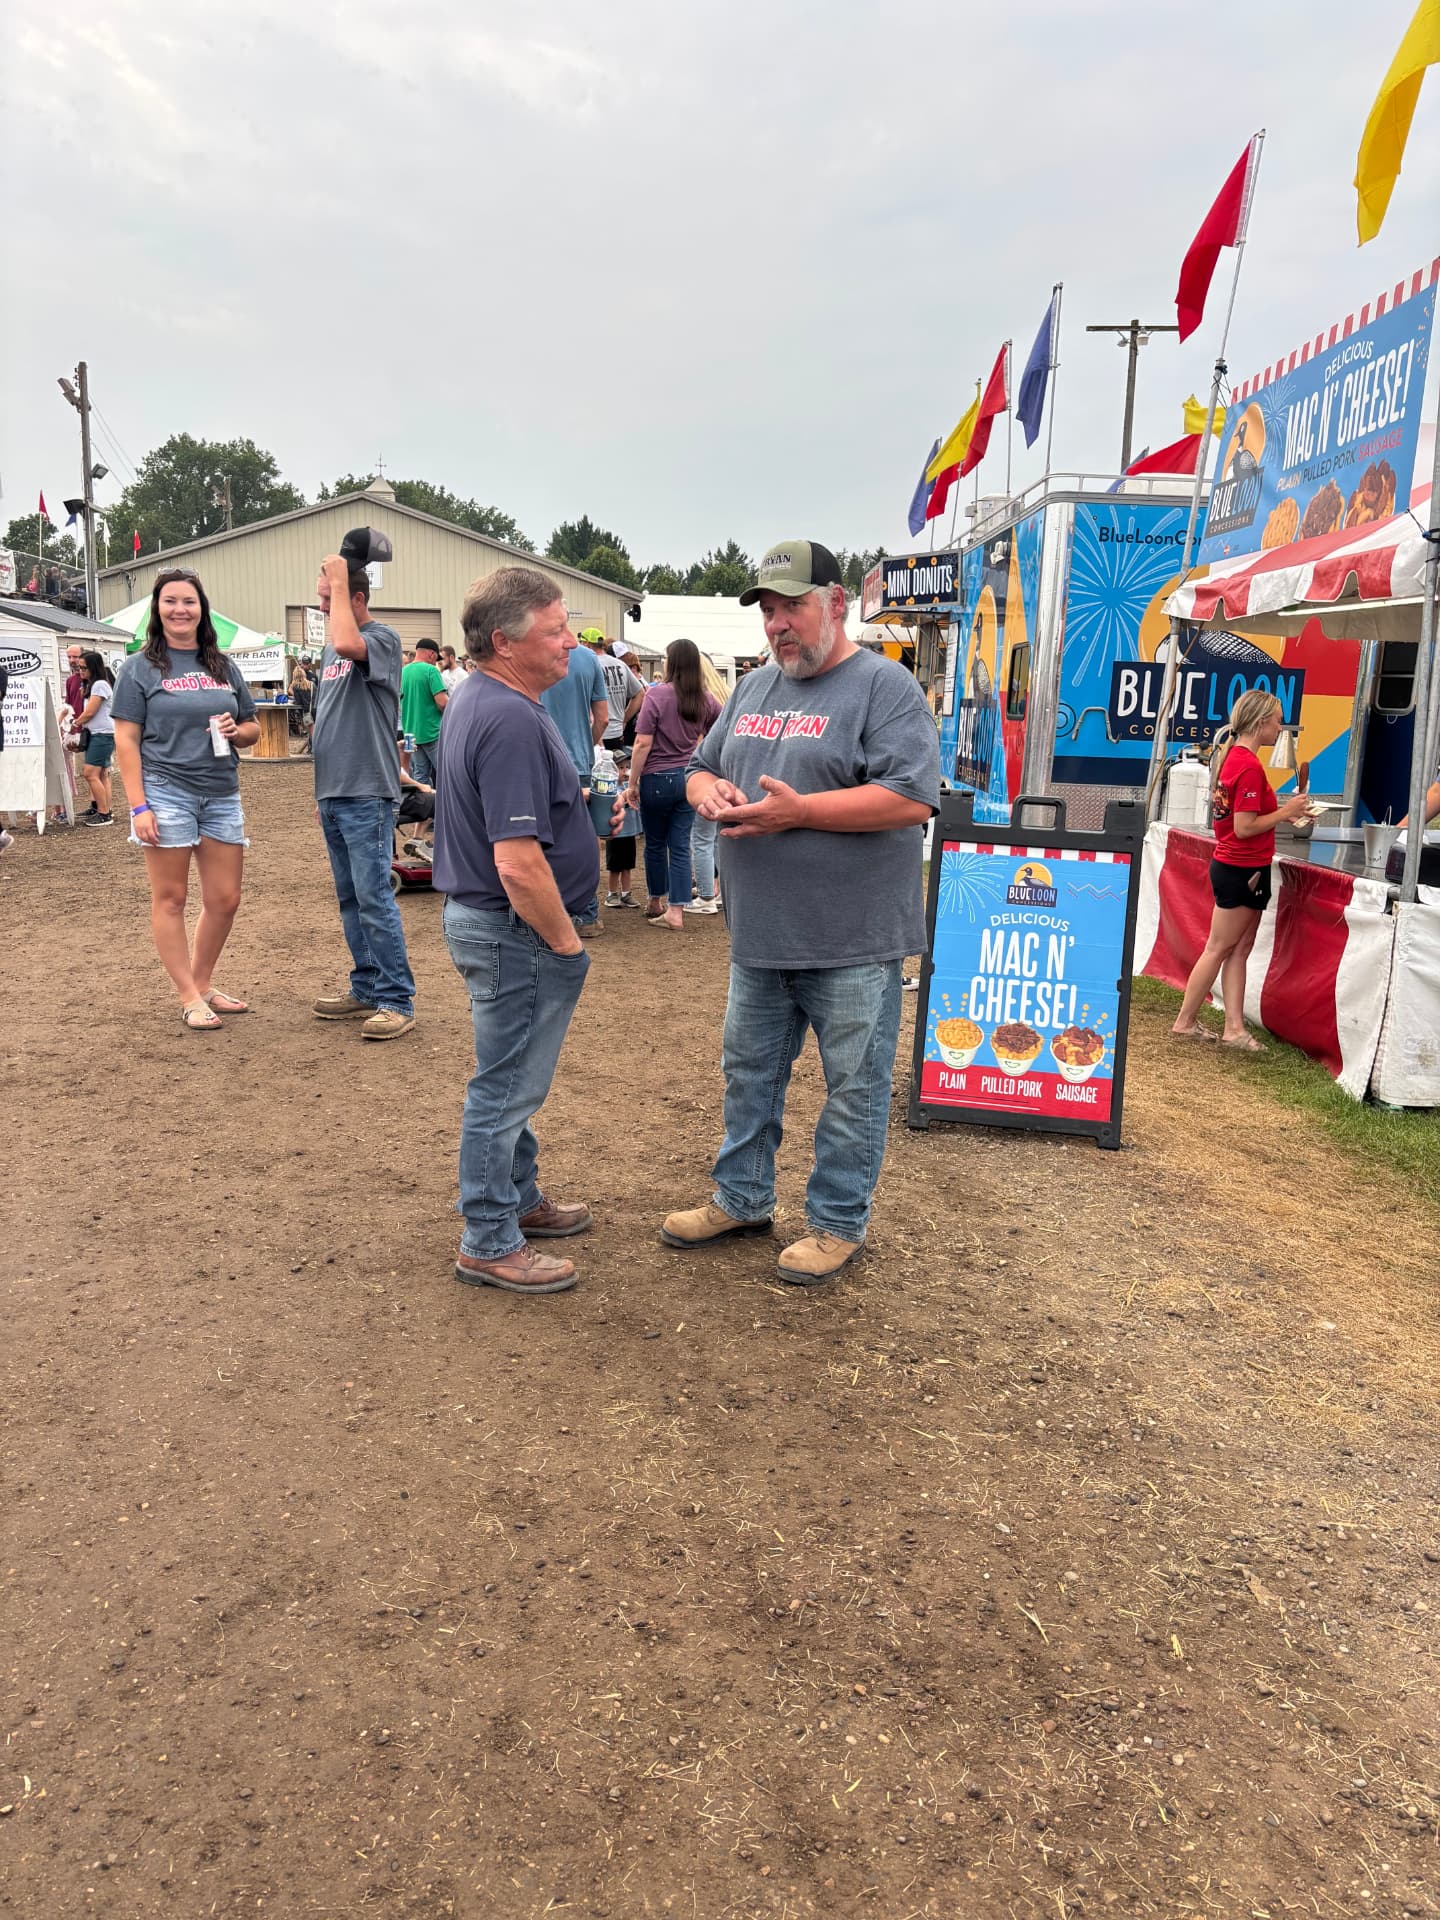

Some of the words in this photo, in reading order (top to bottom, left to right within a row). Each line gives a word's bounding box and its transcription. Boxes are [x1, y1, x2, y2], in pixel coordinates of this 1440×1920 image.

[1324, 340, 1374, 384] DELICIOUS
[1282, 391, 1319, 472] MAC
[1316, 380, 1339, 457] N'
[1337, 338, 1415, 447] CHEESE!
[1275, 472, 1302, 493] PLAIN
[1302, 458, 1332, 484] PULLED
[1332, 446, 1357, 472] PORK
[1357, 428, 1403, 462] SAUSAGE
[1209, 482, 1238, 523] BLUE
[887, 569, 910, 598] MINI
[912, 564, 953, 596] DONUTS
[252, 650, 280, 659] BARN
[162, 676, 200, 692] CHAD
[13, 715, 29, 724] PM
[16, 701, 37, 710] Pull!
[774, 709, 803, 718] VOTE
[734, 713, 783, 740] CHAD
[780, 714, 830, 741] RYAN
[1129, 724, 1219, 738] COCES
[1008, 886, 1032, 900] BLUE
[1032, 888, 1056, 902] LOON
[990, 912, 1070, 932] DELICIOUS
[978, 928, 1040, 978] MAC
[1046, 933, 1075, 981] N'
[968, 975, 1077, 1029] CHEESE!
[938, 1071, 967, 1090] PLAIN
[981, 1075, 1015, 1096] PULLED
[1016, 1079, 1043, 1099] PORK
[1055, 1083, 1099, 1104] SAUSAGE
